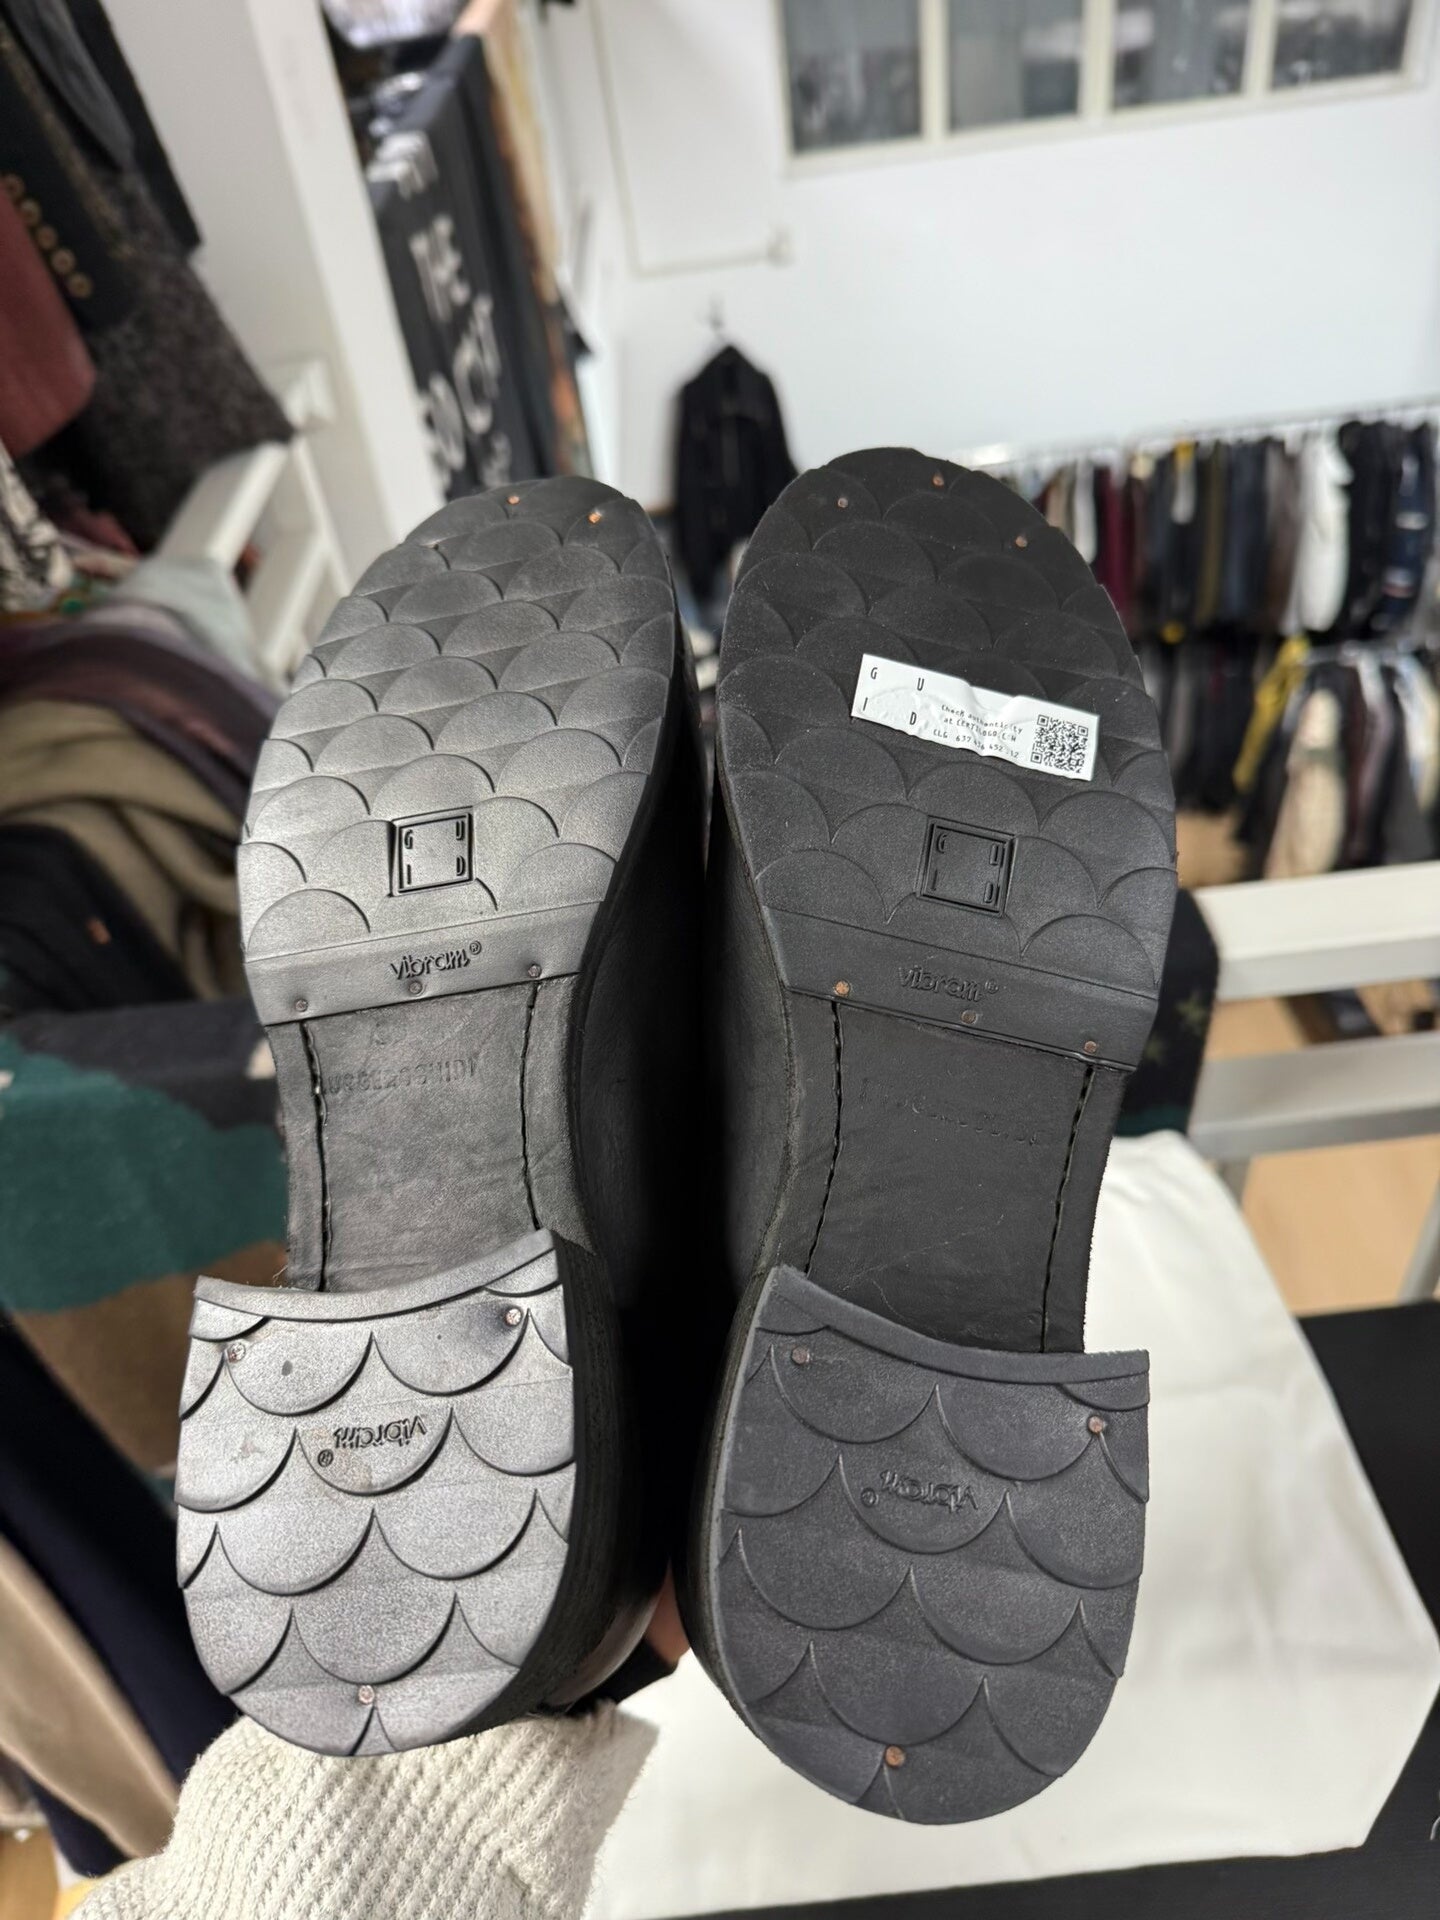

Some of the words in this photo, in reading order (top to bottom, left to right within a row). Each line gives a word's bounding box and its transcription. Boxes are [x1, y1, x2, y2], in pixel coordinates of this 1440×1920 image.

[869, 666, 879, 681] G
[916, 677, 926, 692] U
[908, 711, 918, 726] D
[403, 828, 414, 850] G
[454, 819, 467, 841] U
[455, 854, 467, 877] D
